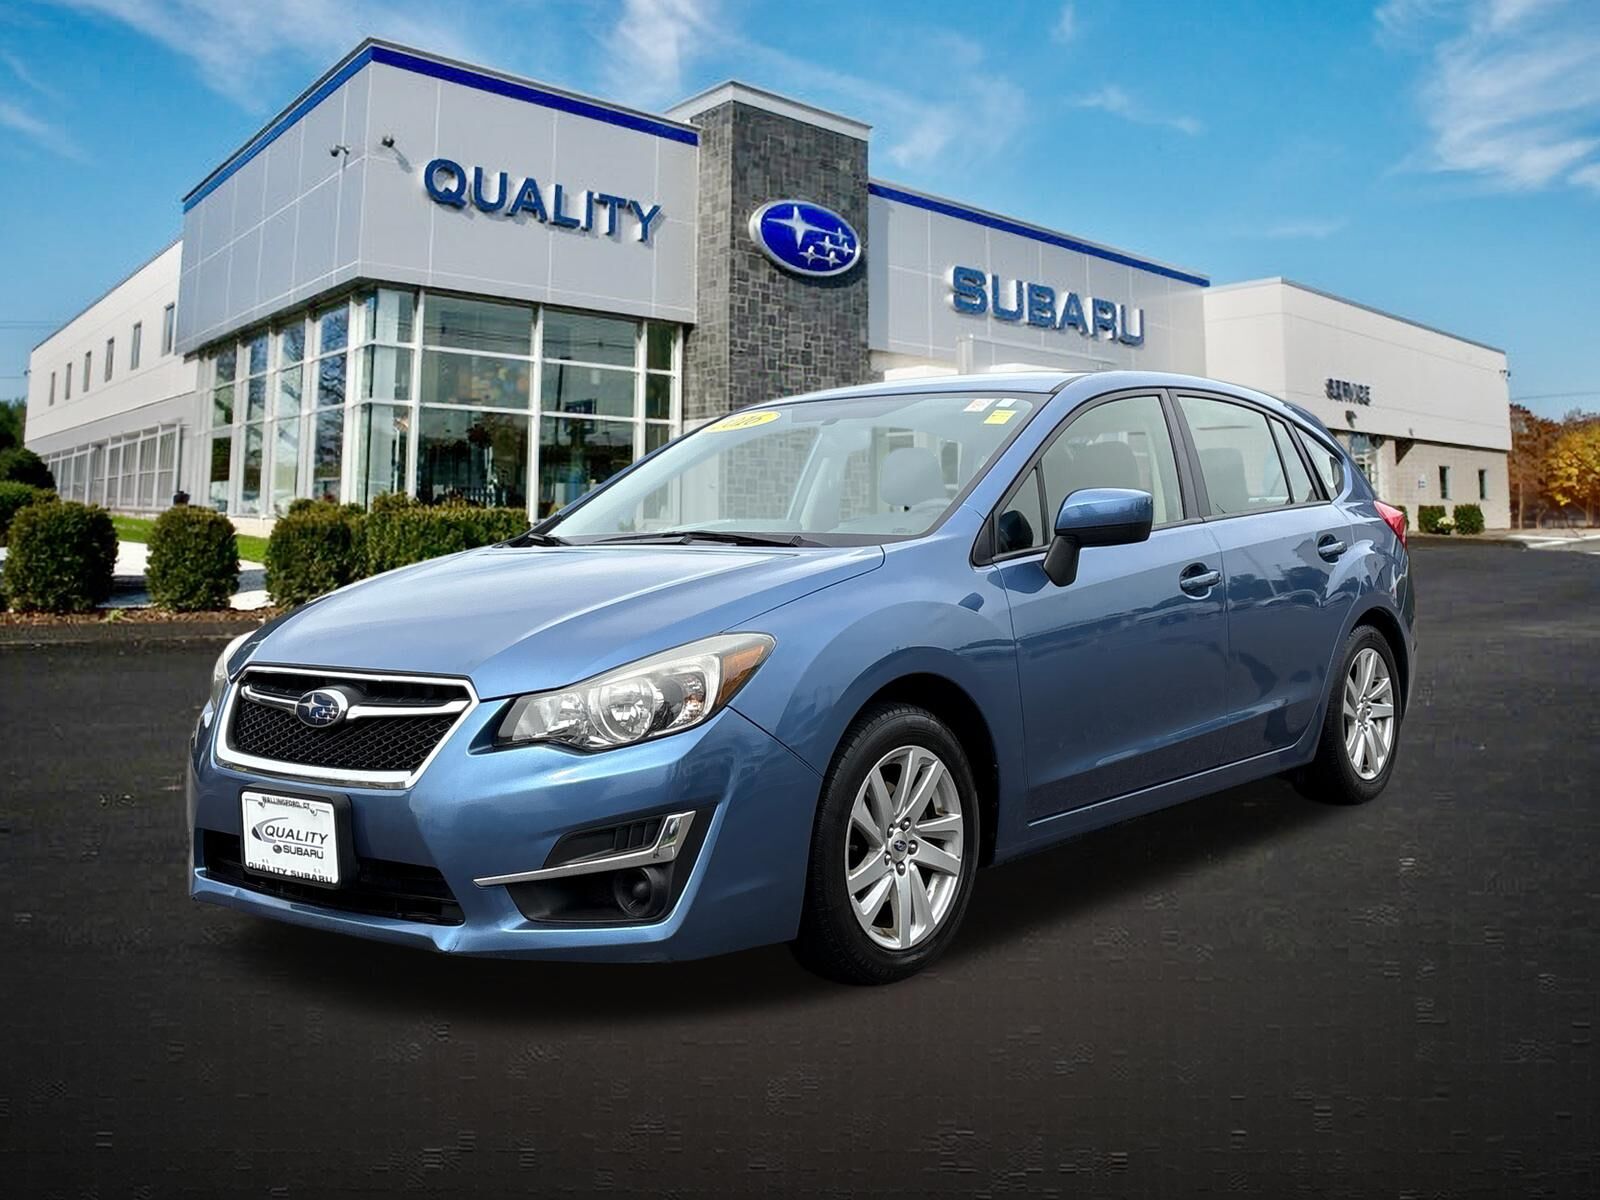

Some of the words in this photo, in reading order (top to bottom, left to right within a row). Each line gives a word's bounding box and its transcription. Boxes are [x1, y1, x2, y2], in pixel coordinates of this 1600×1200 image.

[424, 158, 661, 242] QUALITY
[948, 265, 1145, 347] SUBARU
[264, 825, 328, 845] QUALITY
[282, 844, 324, 859] SUBARU
[248, 861, 287, 876] QUALITY
[290, 869, 333, 883] SUBARU
